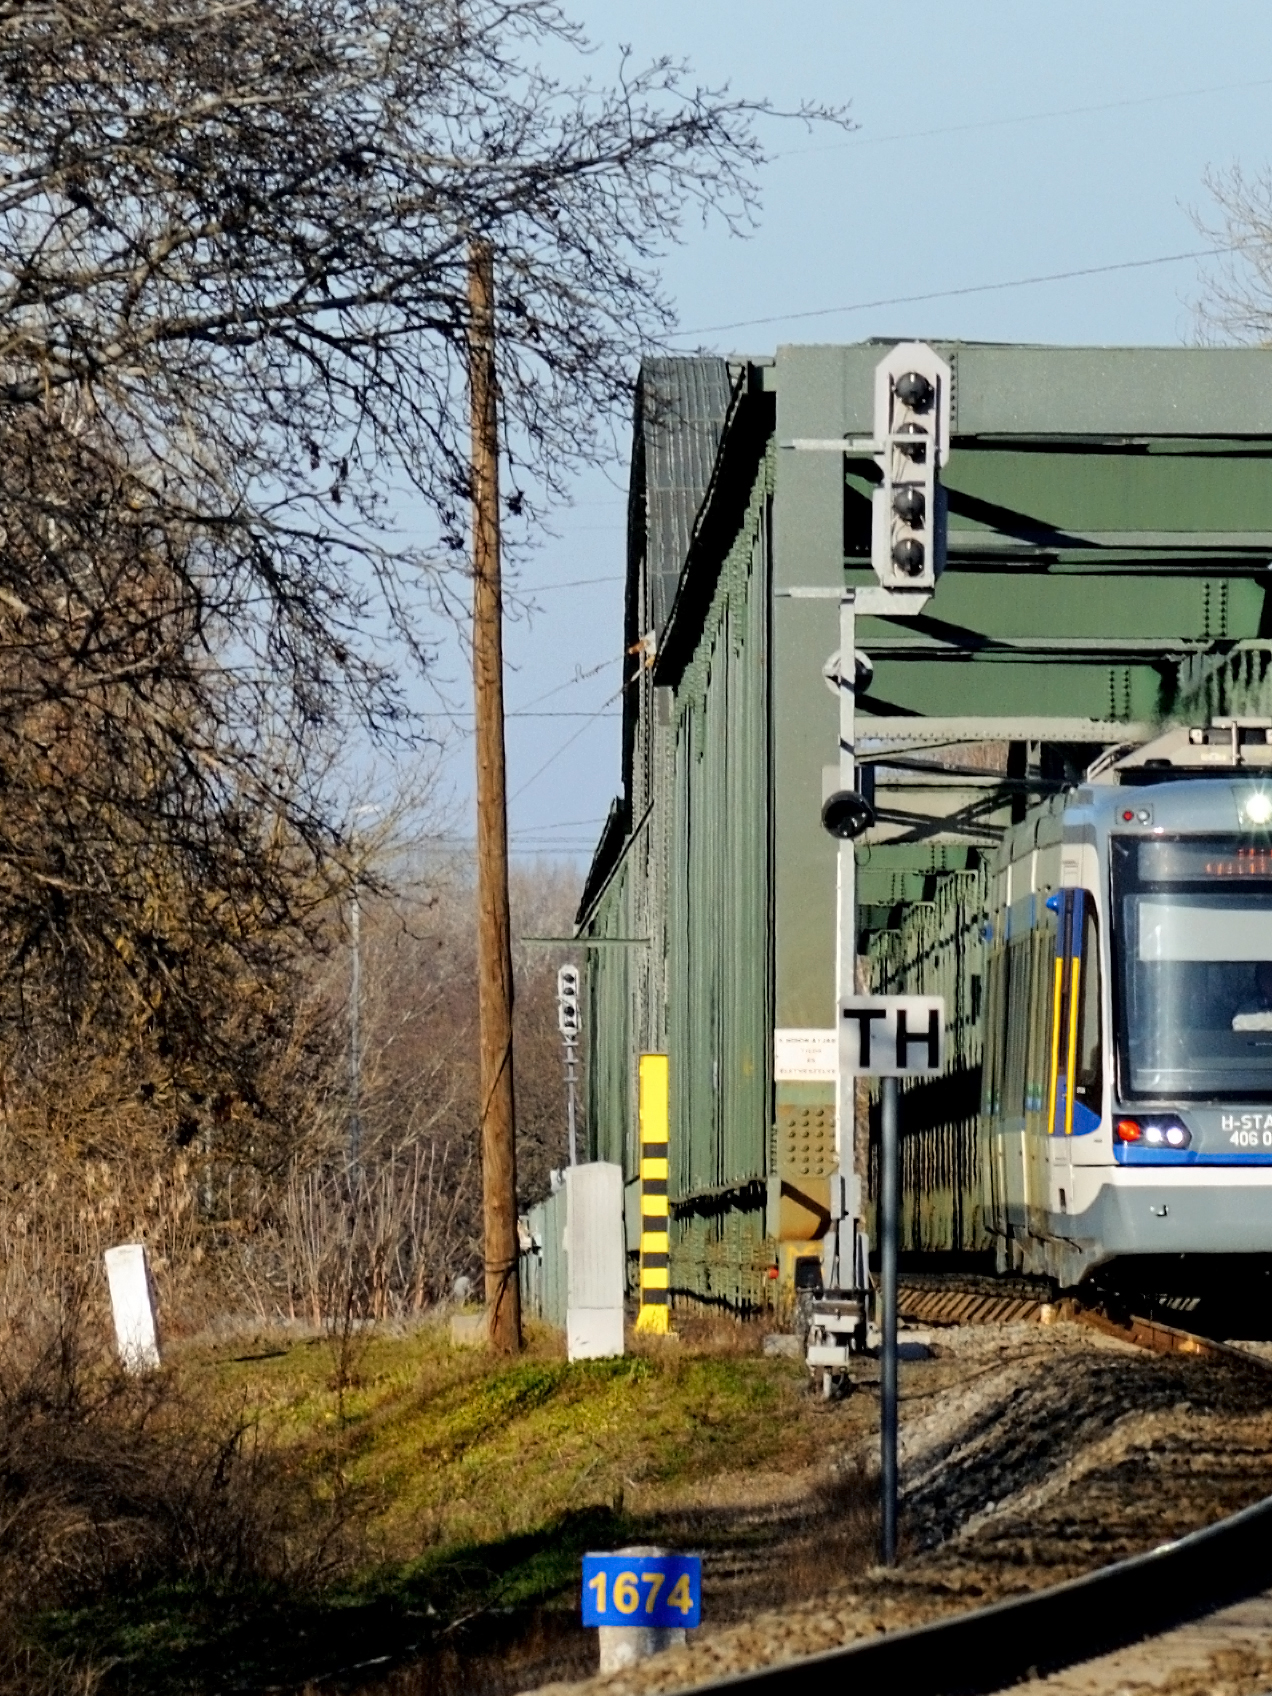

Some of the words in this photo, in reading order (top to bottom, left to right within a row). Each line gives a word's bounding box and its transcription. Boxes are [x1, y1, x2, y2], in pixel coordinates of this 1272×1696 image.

[843, 1008, 940, 1069] TH
[1229, 1130, 1259, 1146] 406
[588, 1570, 694, 1615] 1674
